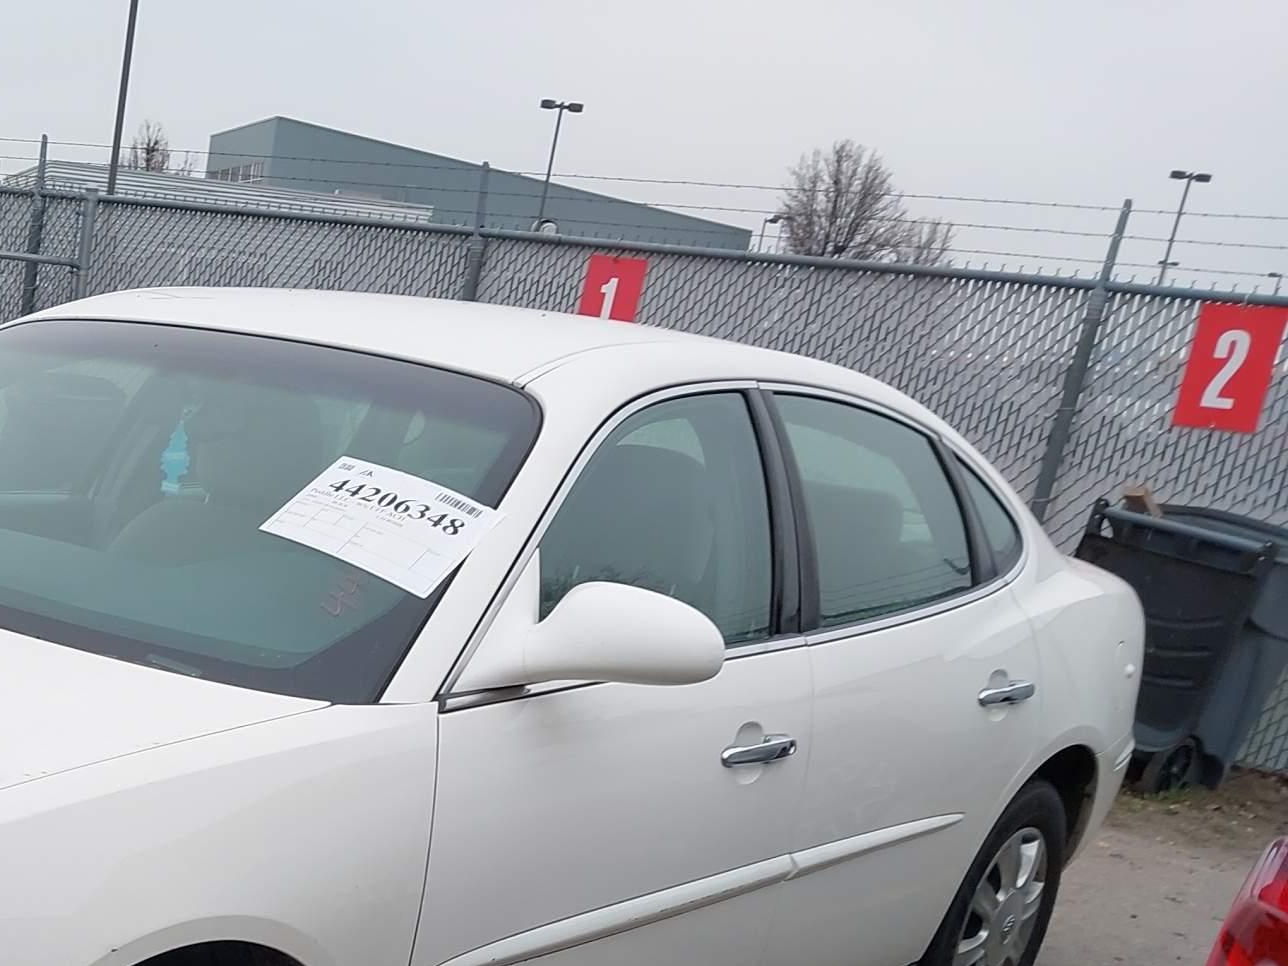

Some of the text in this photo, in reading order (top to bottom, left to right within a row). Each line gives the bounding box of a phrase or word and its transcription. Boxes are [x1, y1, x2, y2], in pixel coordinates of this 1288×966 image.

[599, 277, 619, 320] 1
[1199, 329, 1252, 410] 2
[328, 479, 466, 536] 44206348
